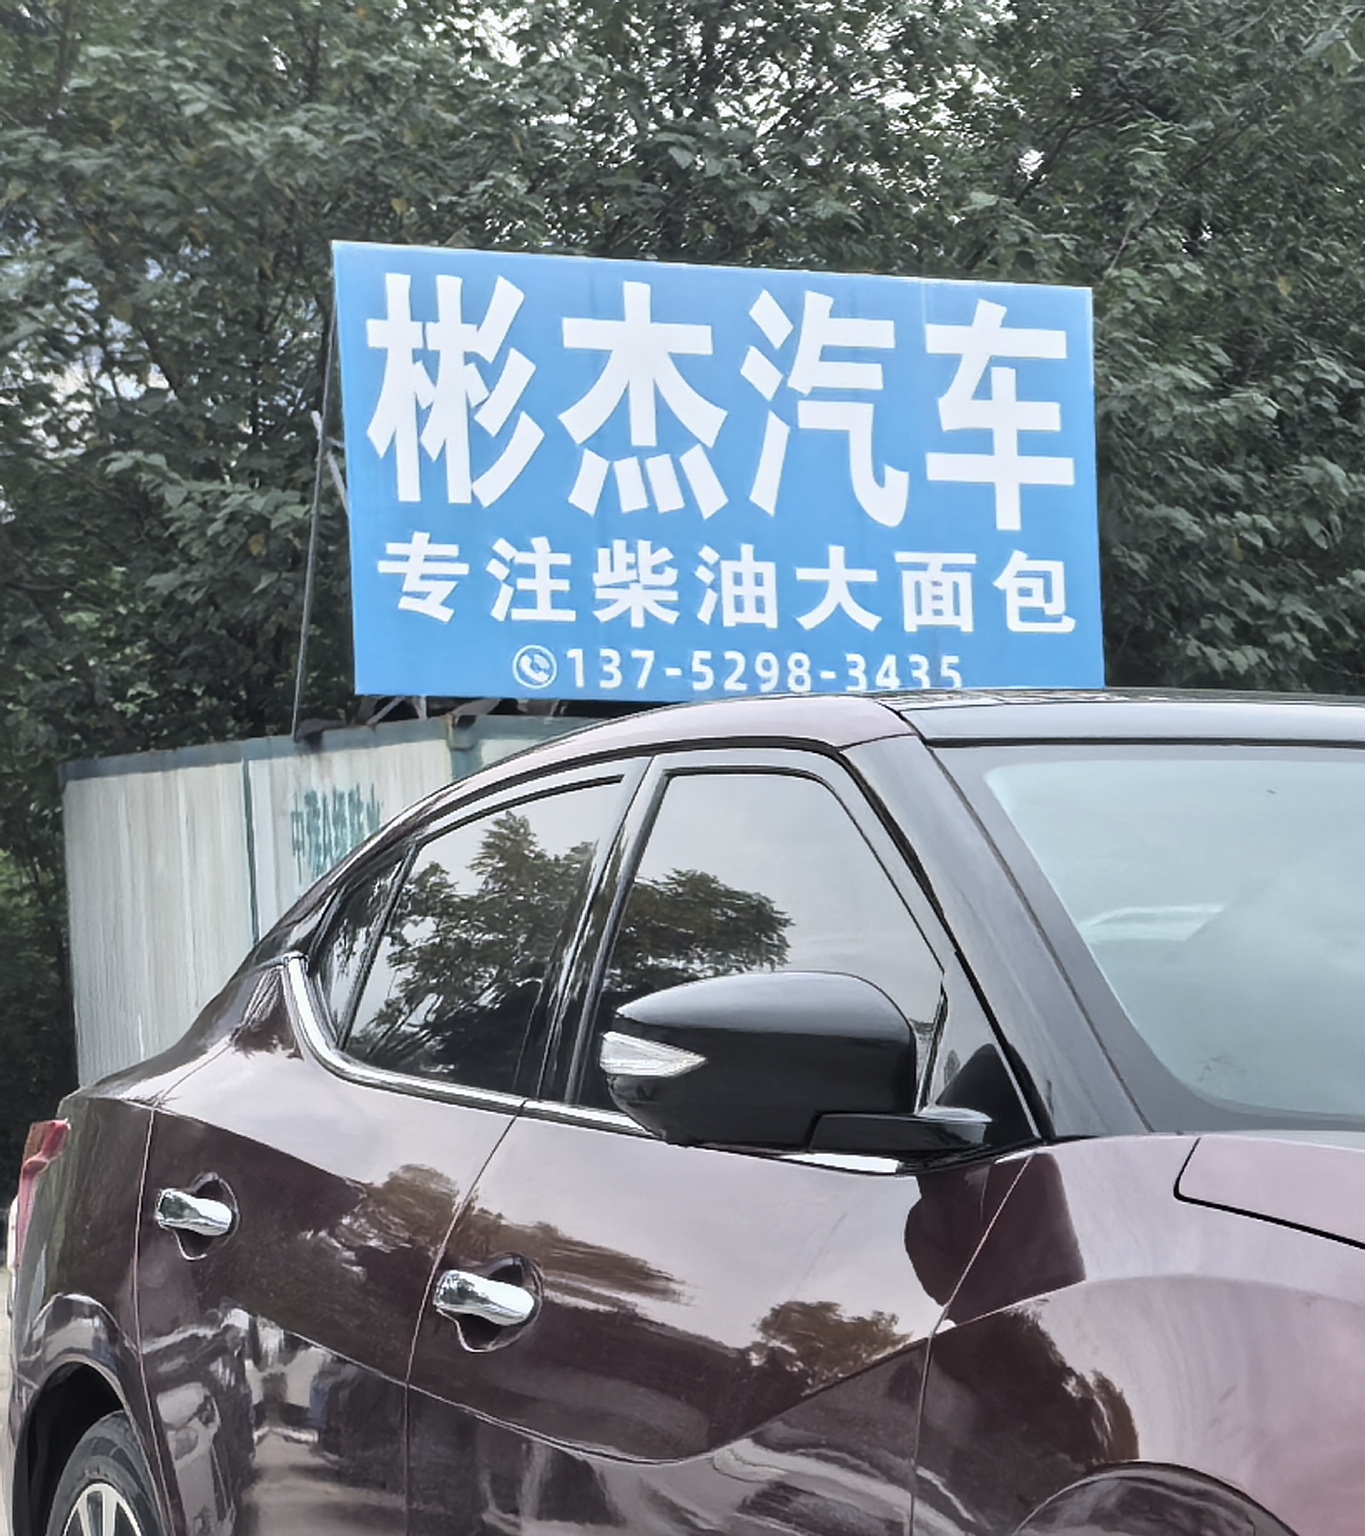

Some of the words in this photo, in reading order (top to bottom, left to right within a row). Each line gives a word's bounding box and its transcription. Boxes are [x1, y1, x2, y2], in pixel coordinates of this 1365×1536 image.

[366, 272, 1073, 531] 彬杰汽车
[378, 531, 1075, 633] 专注柴油大面包
[567, 648, 962, 692] 137-5298-3435
